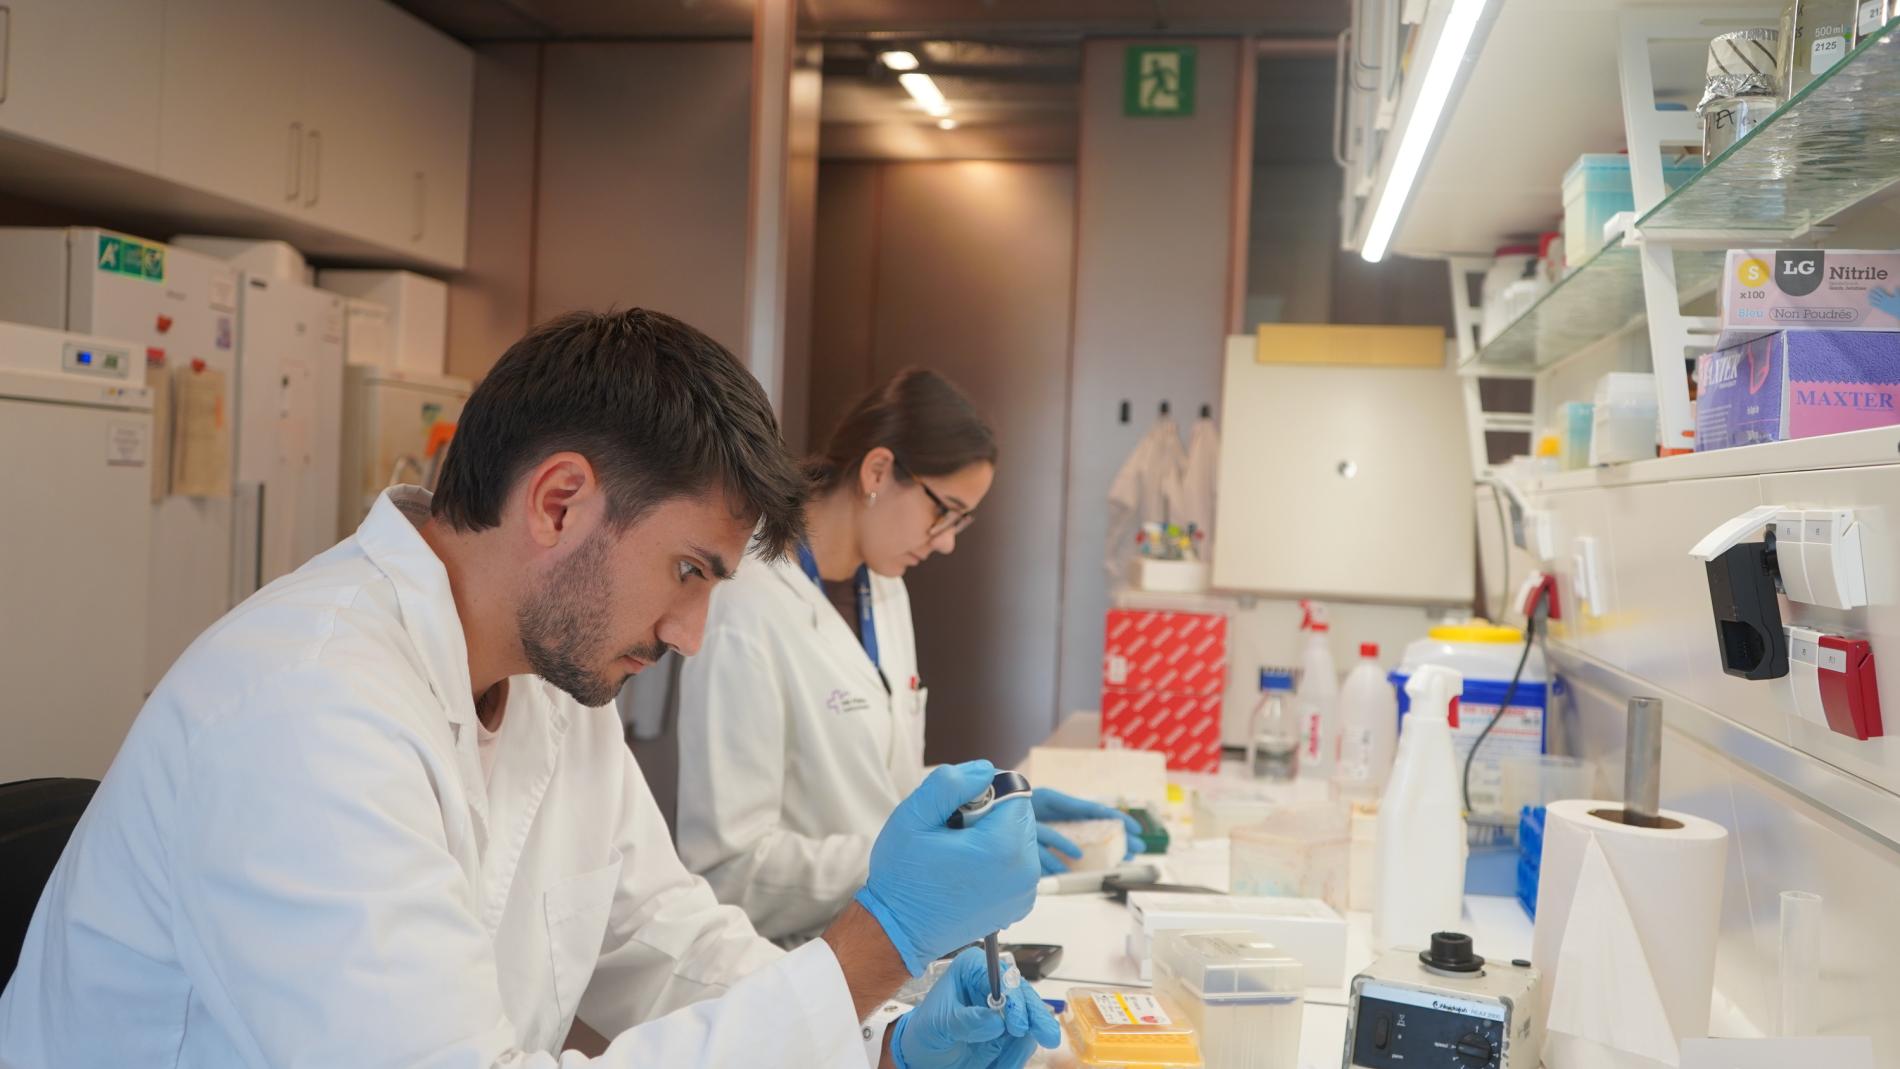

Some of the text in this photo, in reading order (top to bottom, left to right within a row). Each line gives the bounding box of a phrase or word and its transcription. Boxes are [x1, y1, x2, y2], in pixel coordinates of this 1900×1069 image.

[1815, 41, 1837, 52] 2125
[1747, 267, 1760, 281] S
[1783, 260, 1815, 275] LG
[1829, 265, 1889, 281] Nitrile
[1739, 291, 1765, 300] x100
[1737, 308, 1852, 320] Bleu Non Poudrés
[1796, 390, 1895, 408] MAXTER
